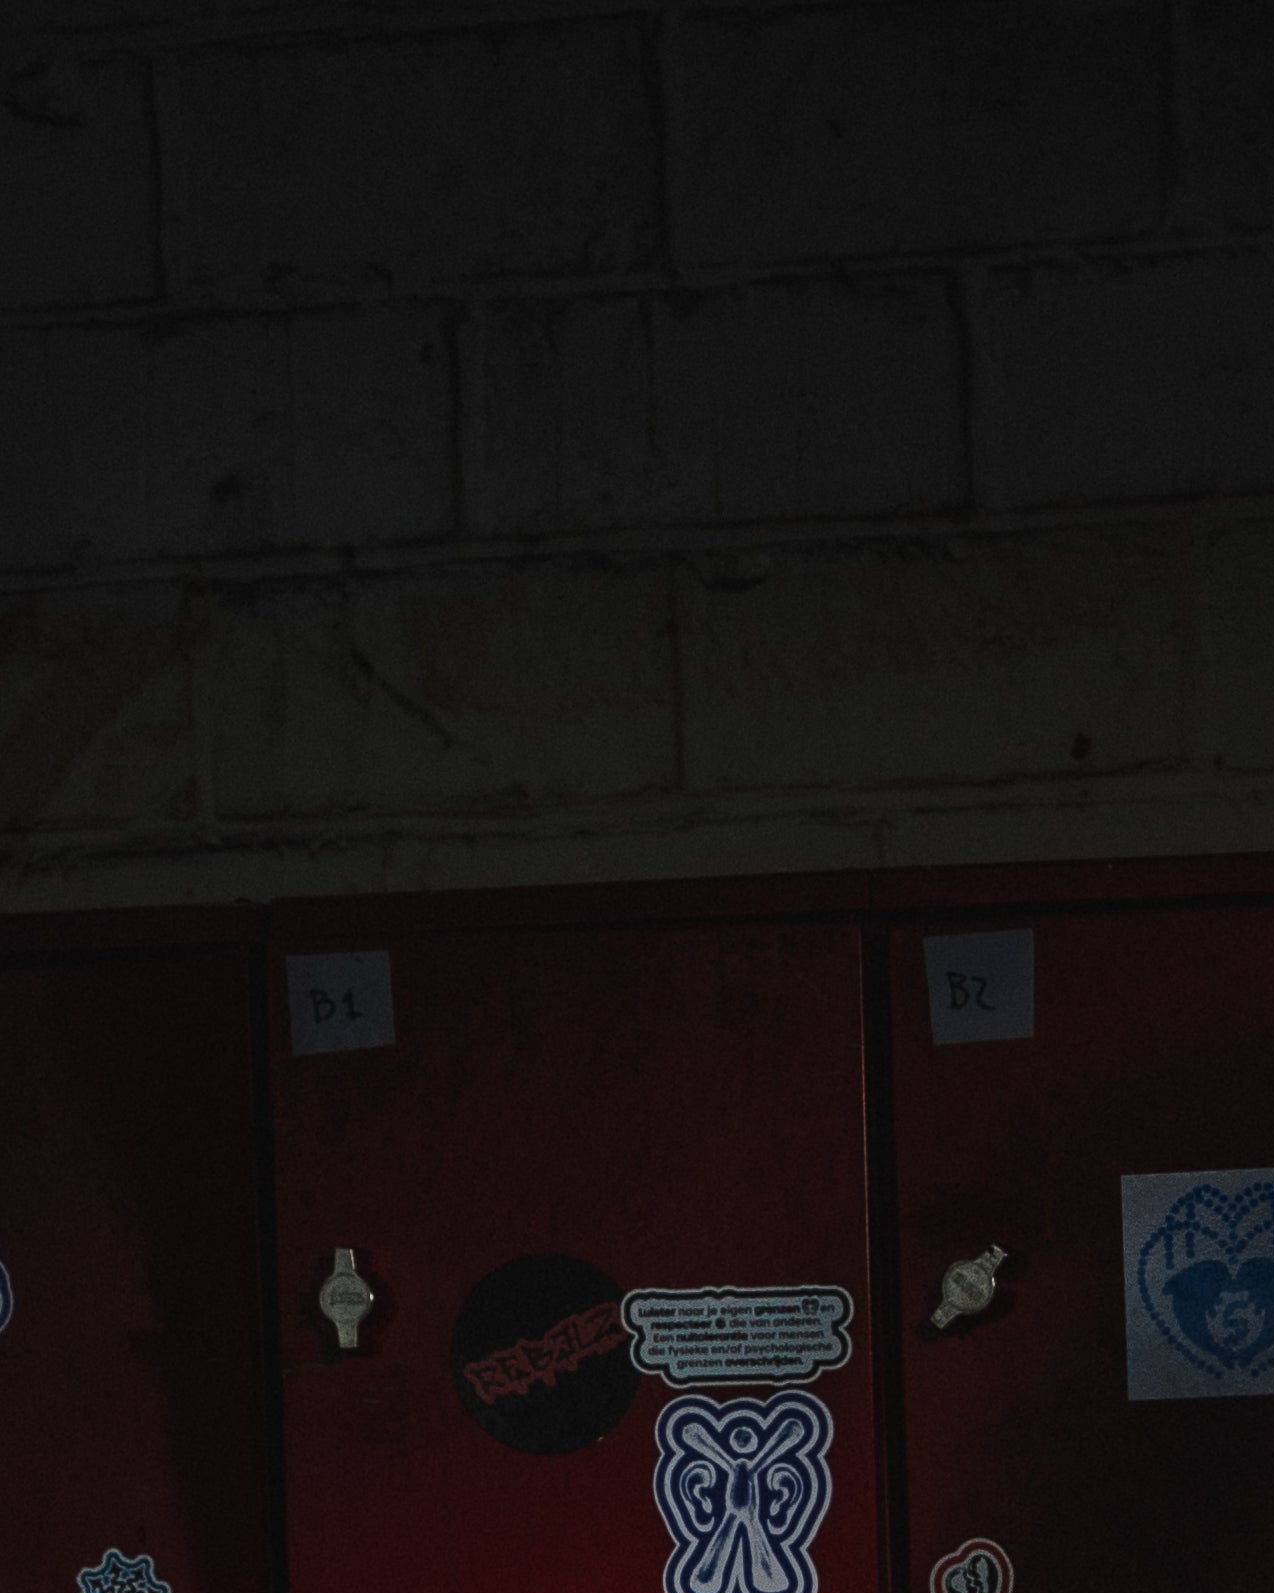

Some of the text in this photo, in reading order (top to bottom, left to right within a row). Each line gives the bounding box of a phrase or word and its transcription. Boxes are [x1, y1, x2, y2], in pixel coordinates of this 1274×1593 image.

[946, 970, 995, 1011] B2
[309, 987, 362, 1024] B1
[678, 1307, 705, 1316] naar
[707, 1304, 718, 1317] je
[720, 1304, 752, 1316] eigen
[754, 1305, 801, 1316] grenzen
[820, 1304, 835, 1313] en
[651, 1320, 712, 1331] respecteer
[729, 1318, 747, 1328] die
[749, 1319, 770, 1328] van
[677, 1359, 723, 1370] grenzen
